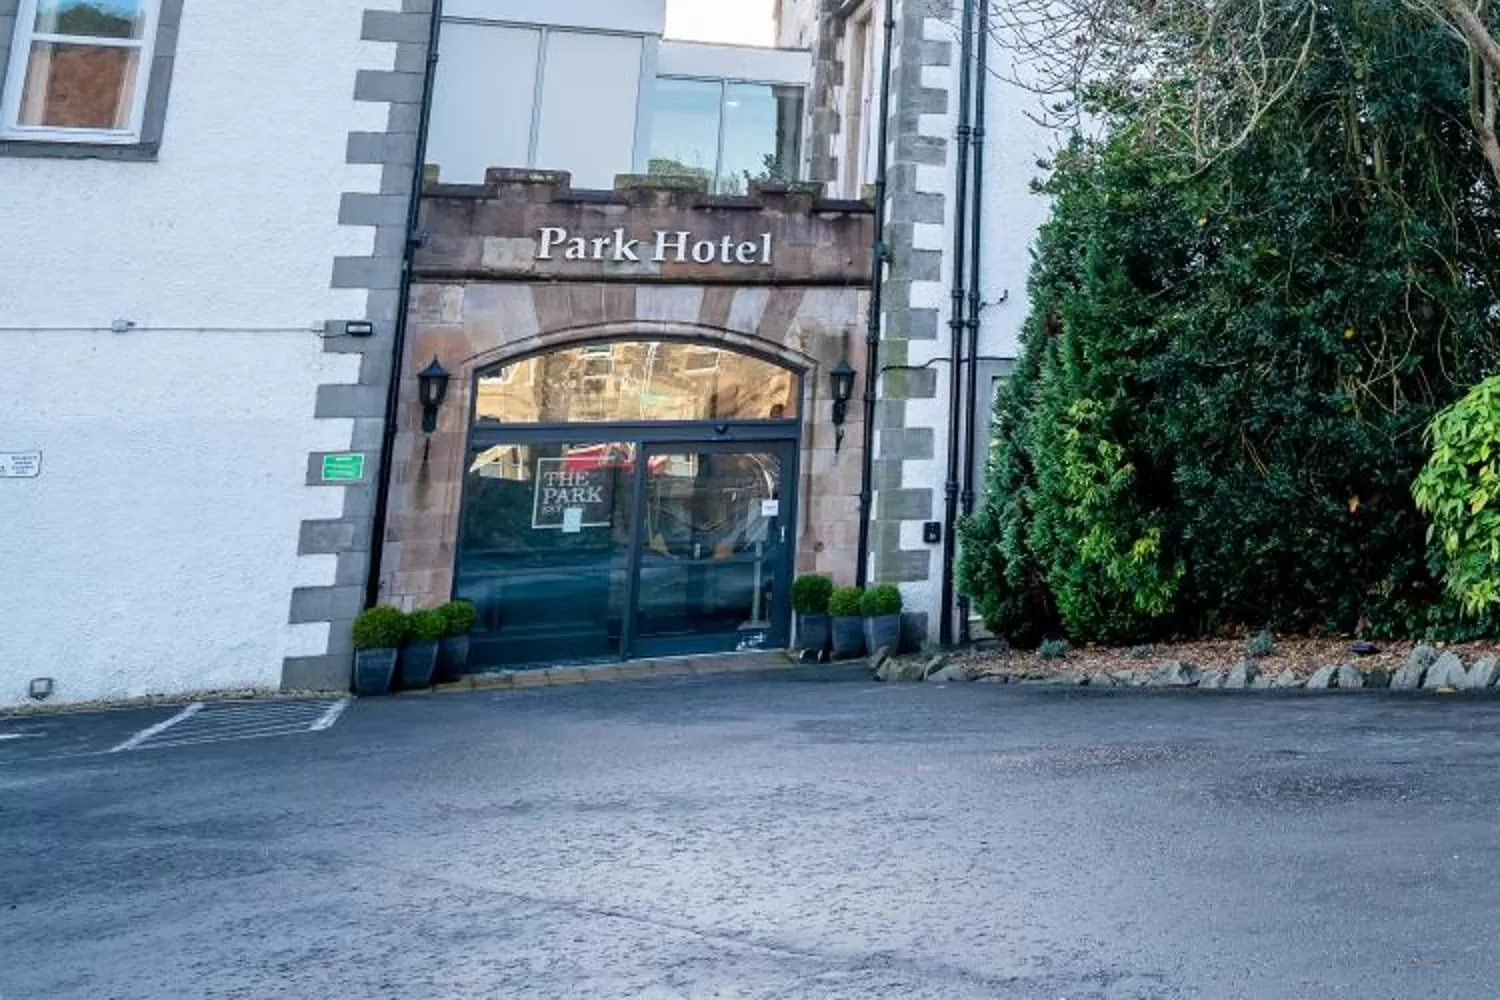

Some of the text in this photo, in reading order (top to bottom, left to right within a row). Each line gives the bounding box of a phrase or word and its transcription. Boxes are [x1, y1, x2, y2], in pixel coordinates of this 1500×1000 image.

[535, 227, 773, 264] Park Hotel
[543, 471, 590, 487] THE
[541, 486, 604, 505] PARK
